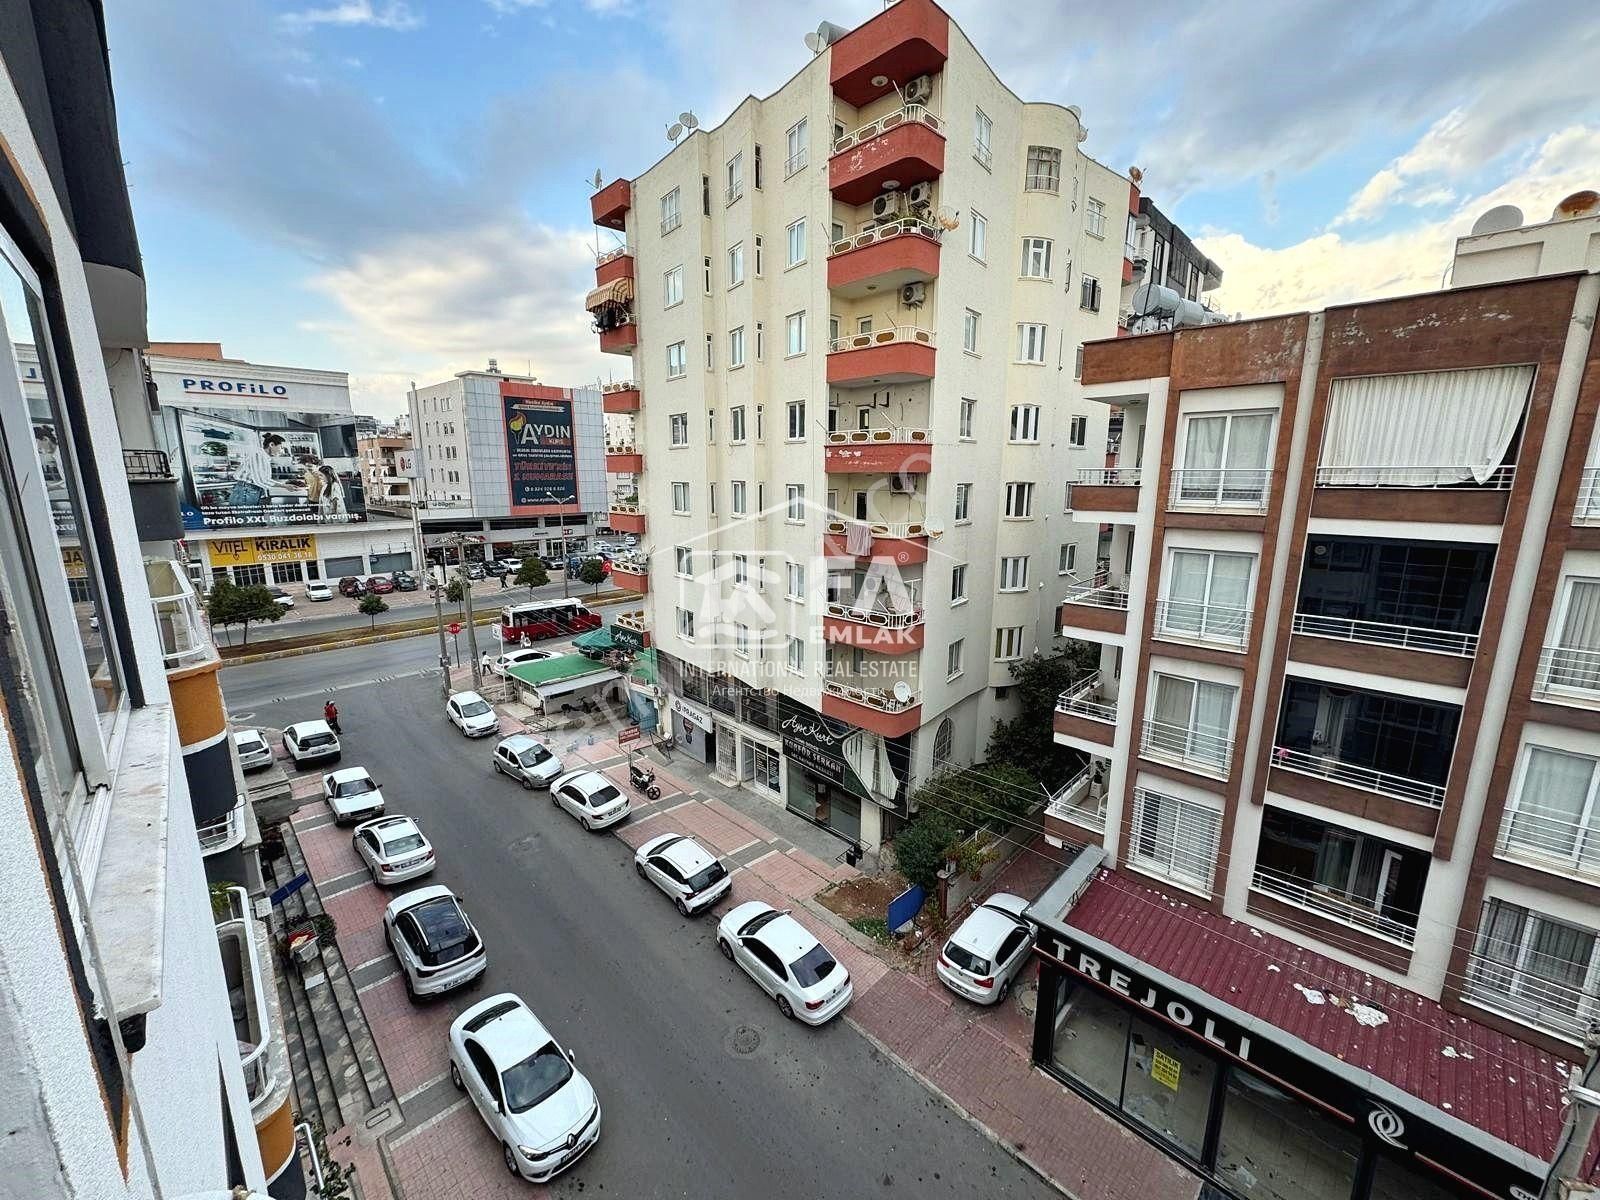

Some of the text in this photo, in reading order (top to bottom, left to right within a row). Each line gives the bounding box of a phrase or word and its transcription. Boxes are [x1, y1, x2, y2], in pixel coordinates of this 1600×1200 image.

[521, 423, 571, 445] AYDIN
[203, 514, 244, 526] Profilo
[246, 514, 267, 524] XXL
[1051, 938, 1252, 1061] TREJOLI
